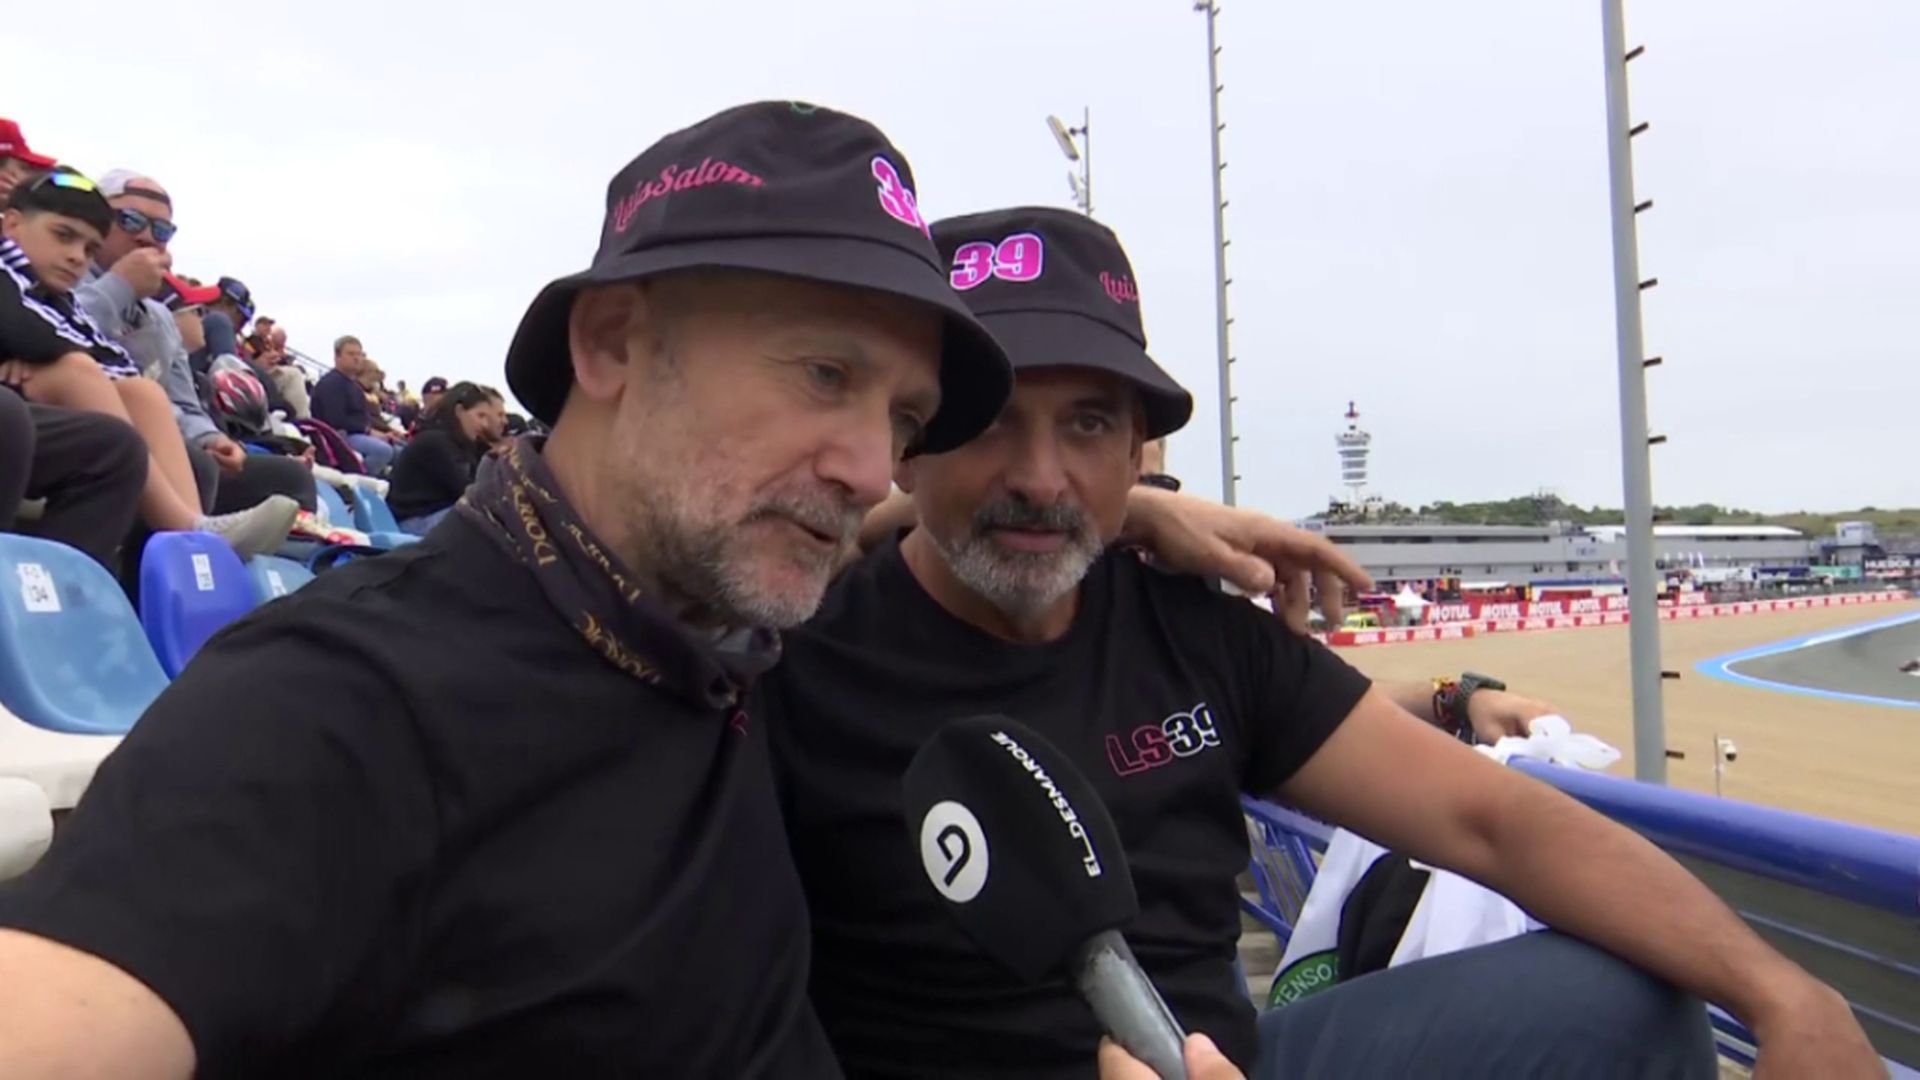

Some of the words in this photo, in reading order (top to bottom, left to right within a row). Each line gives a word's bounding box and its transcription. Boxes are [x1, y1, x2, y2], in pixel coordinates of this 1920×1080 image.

[950, 232, 1043, 291] 39
[1428, 604, 1471, 622] MOTUL
[1480, 603, 1519, 619] MOTUL
